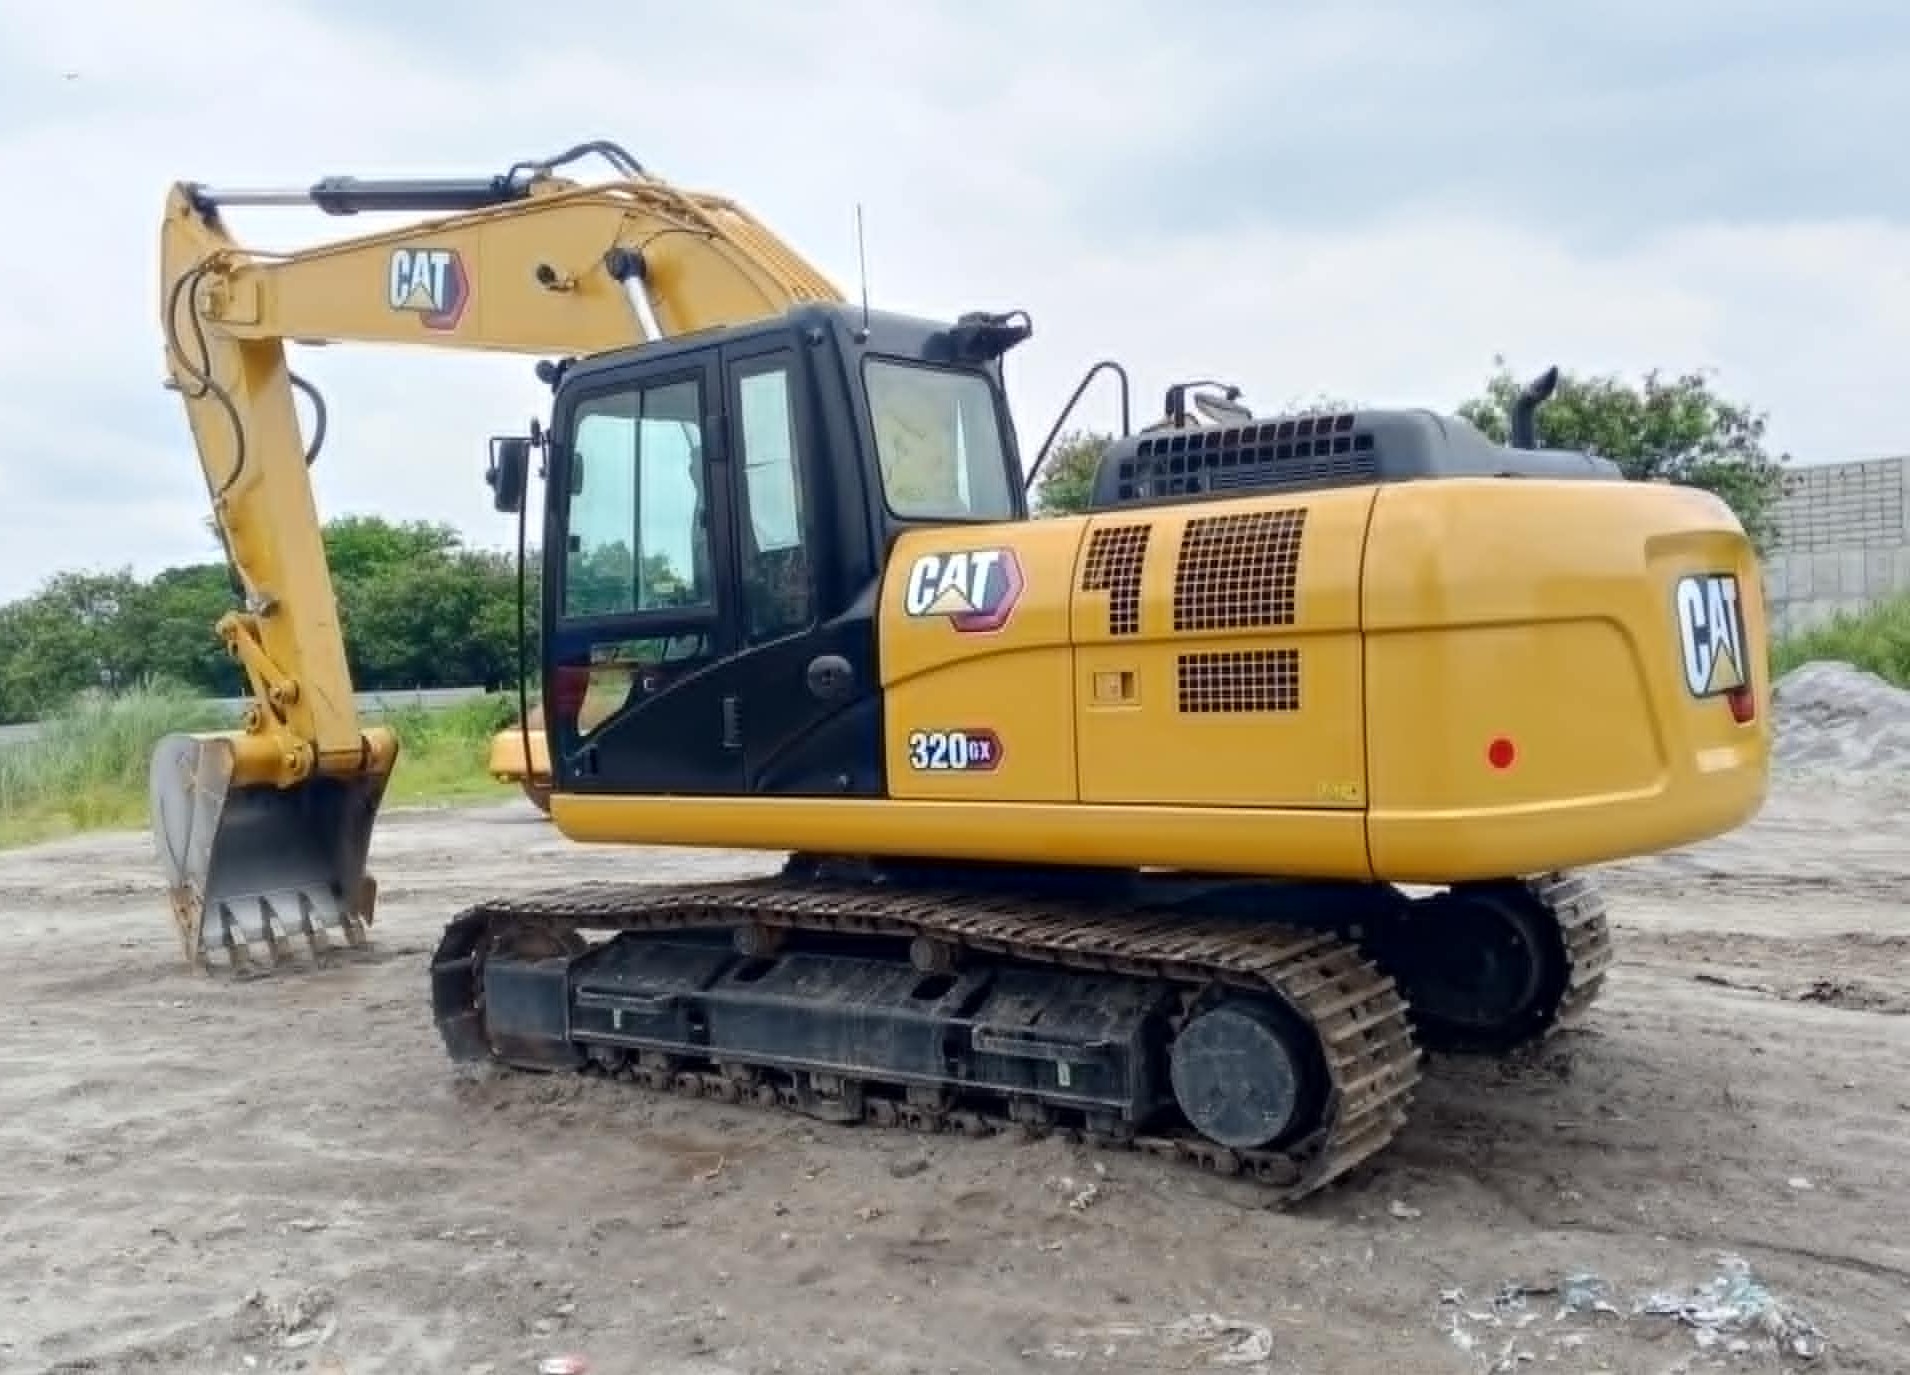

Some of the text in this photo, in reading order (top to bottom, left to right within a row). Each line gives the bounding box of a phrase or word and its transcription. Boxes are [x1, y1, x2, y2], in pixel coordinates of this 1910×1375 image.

[391, 251, 450, 310] CAT
[907, 551, 999, 615] CAT
[1677, 577, 1745, 695] CAT
